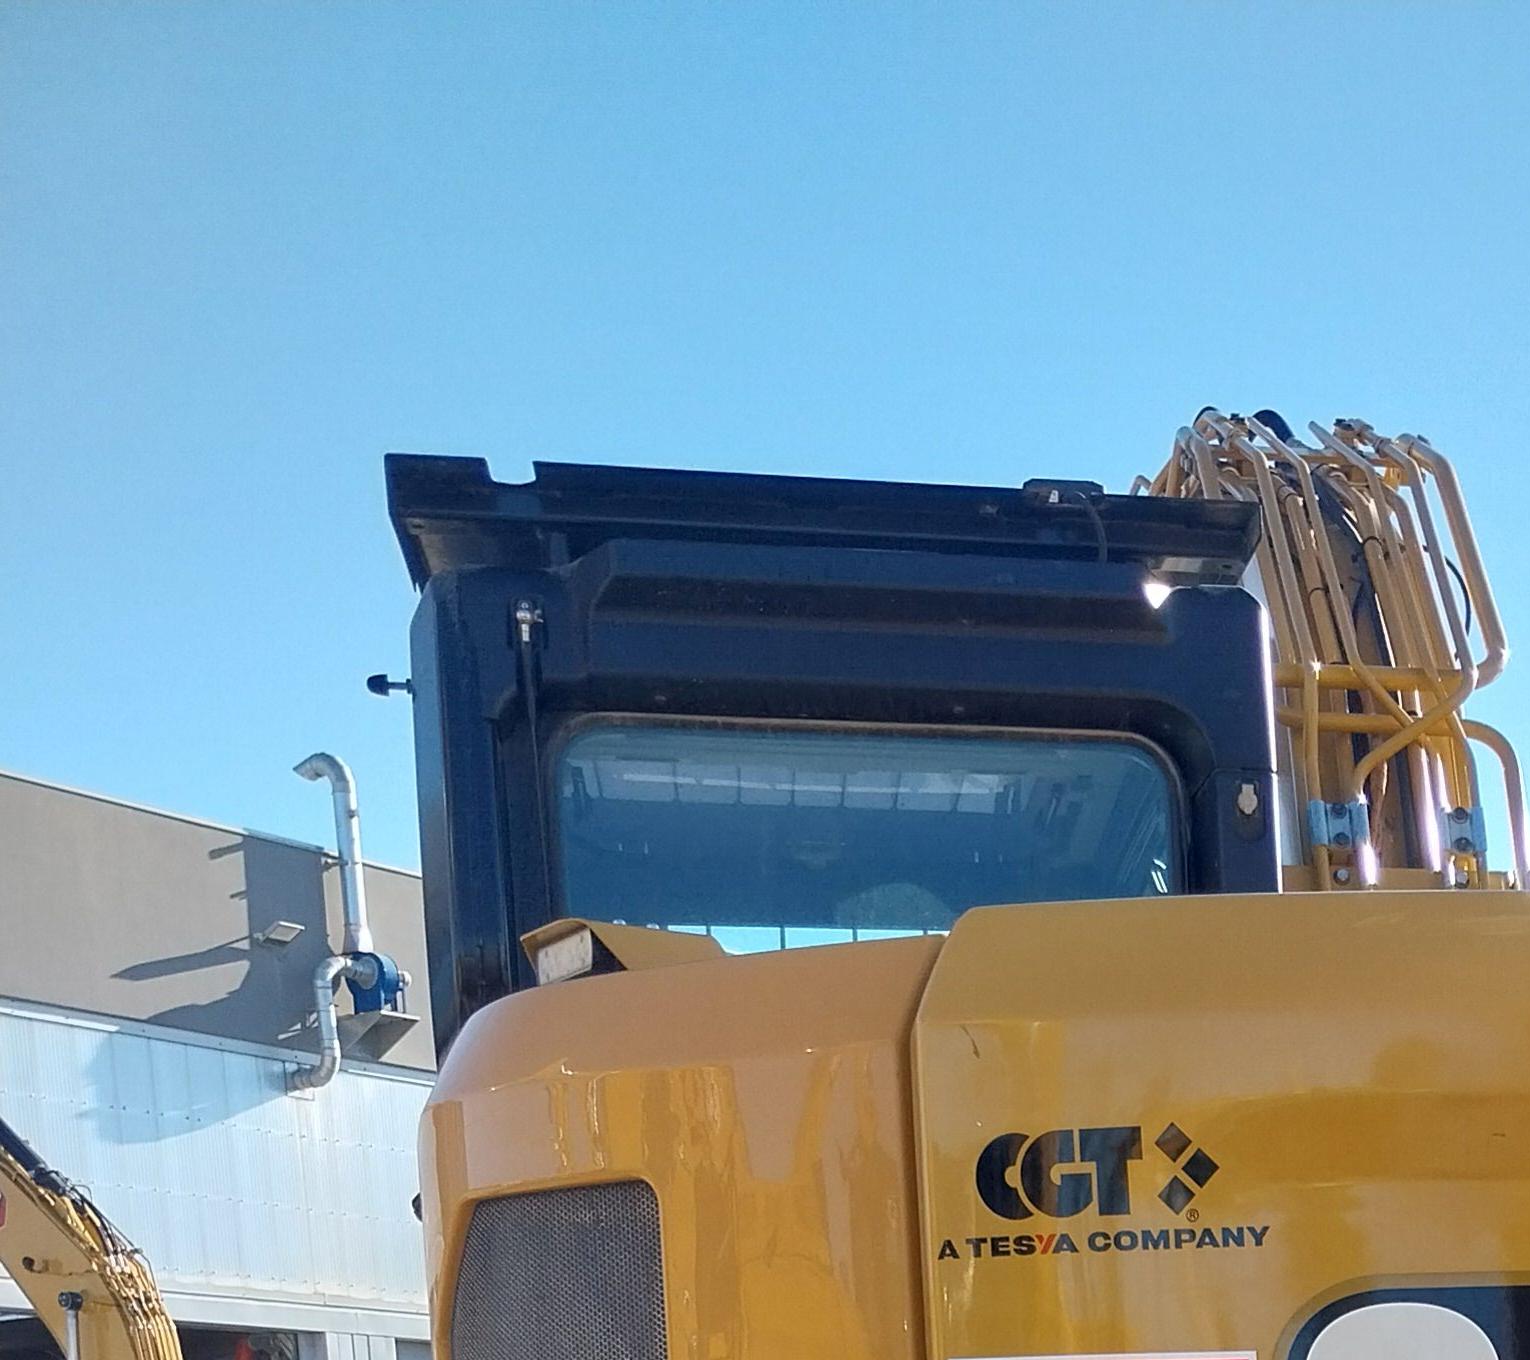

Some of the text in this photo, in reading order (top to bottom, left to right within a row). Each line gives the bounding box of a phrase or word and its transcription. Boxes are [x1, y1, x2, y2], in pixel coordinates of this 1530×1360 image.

[975, 1126, 1143, 1220] CGT
[938, 1226, 1270, 1260] A TESYA COMPANY
